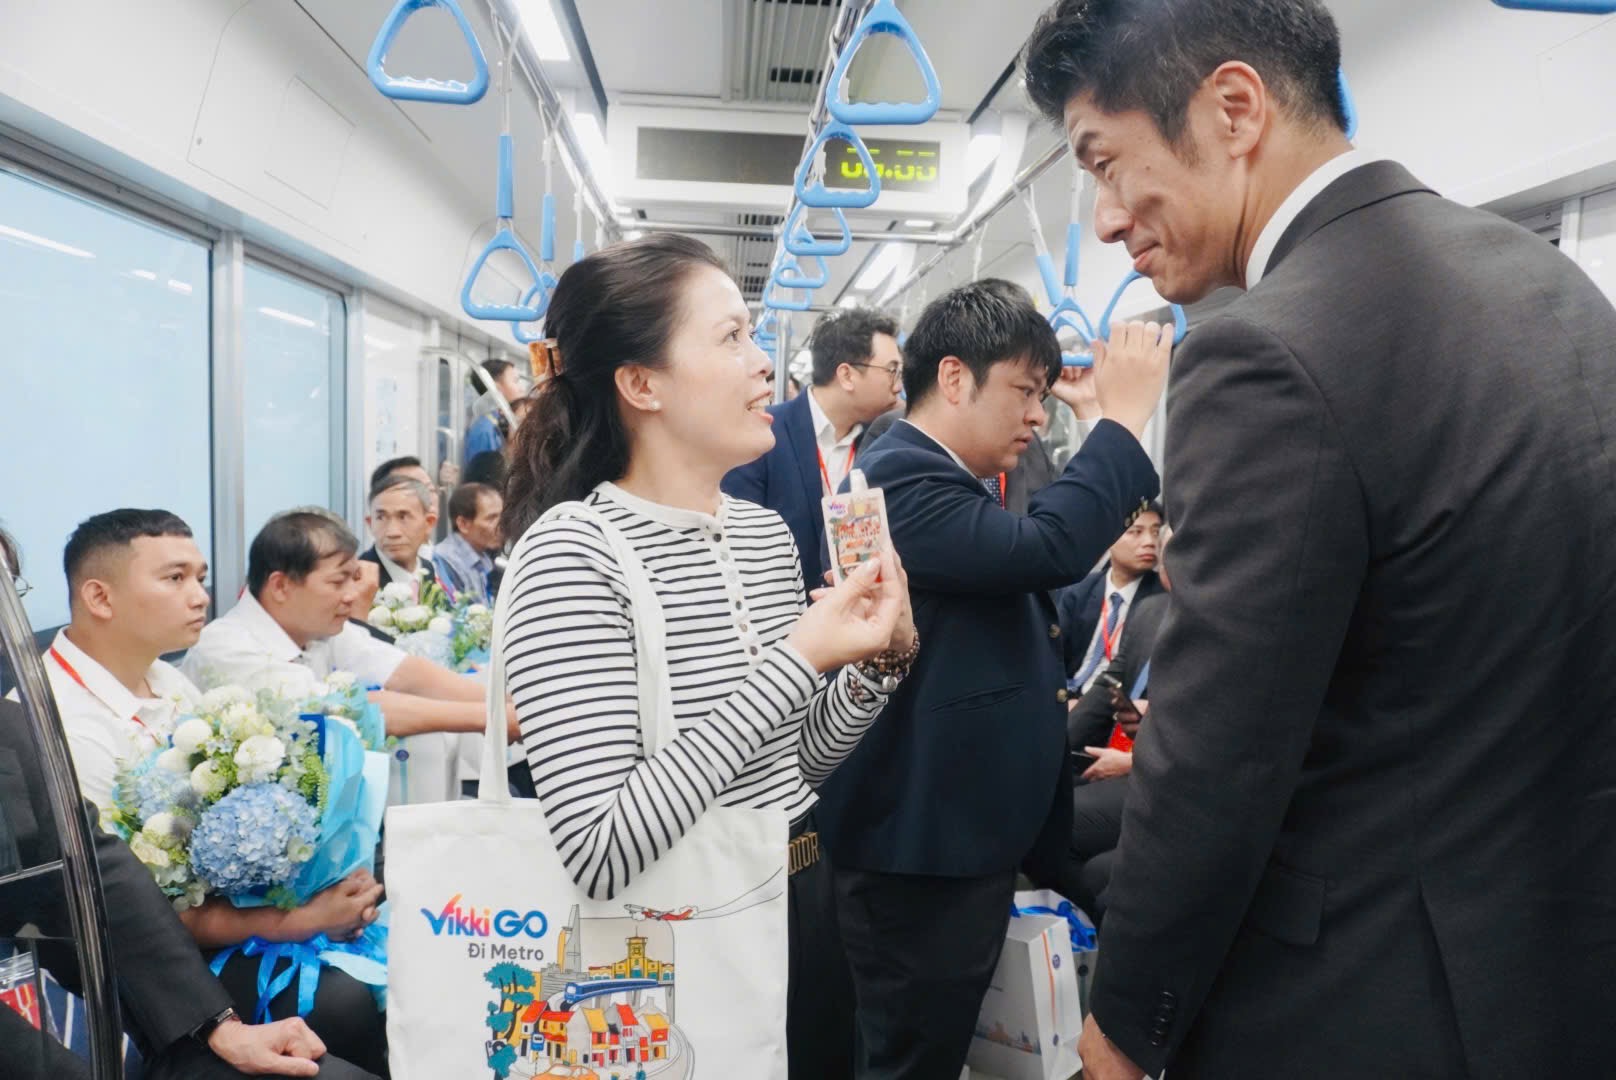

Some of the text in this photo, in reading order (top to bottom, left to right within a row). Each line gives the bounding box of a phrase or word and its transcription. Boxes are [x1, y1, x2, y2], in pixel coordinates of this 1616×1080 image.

[787, 832, 820, 876] DIOR
[467, 942, 545, 961] Đi Metro
